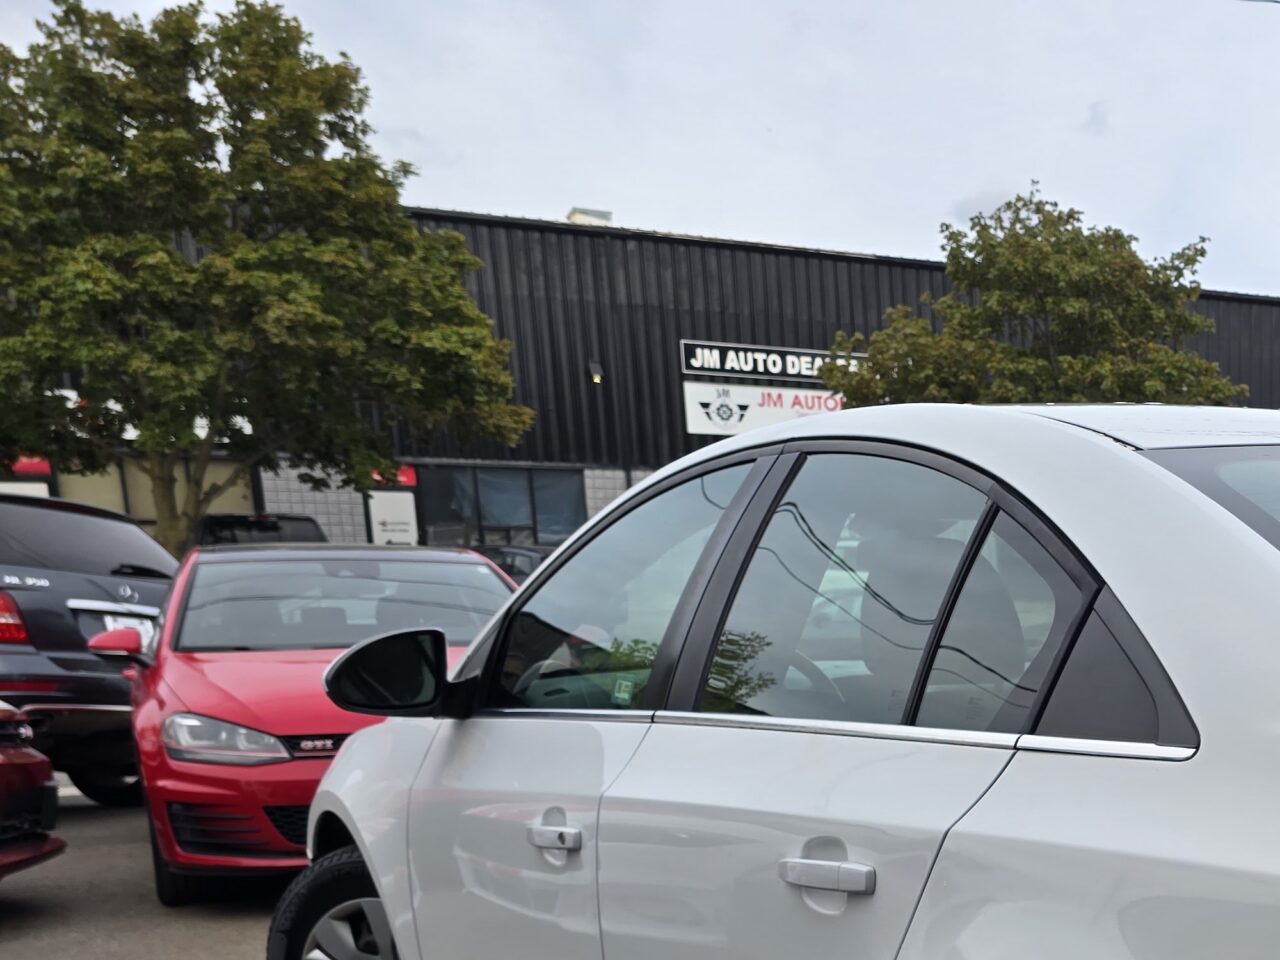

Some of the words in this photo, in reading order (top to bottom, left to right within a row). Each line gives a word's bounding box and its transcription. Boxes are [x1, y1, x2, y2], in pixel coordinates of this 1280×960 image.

[690, 348, 720, 369] JM
[725, 350, 782, 374] AUTO
[758, 392, 783, 408] JM
[301, 739, 333, 750] GTI
